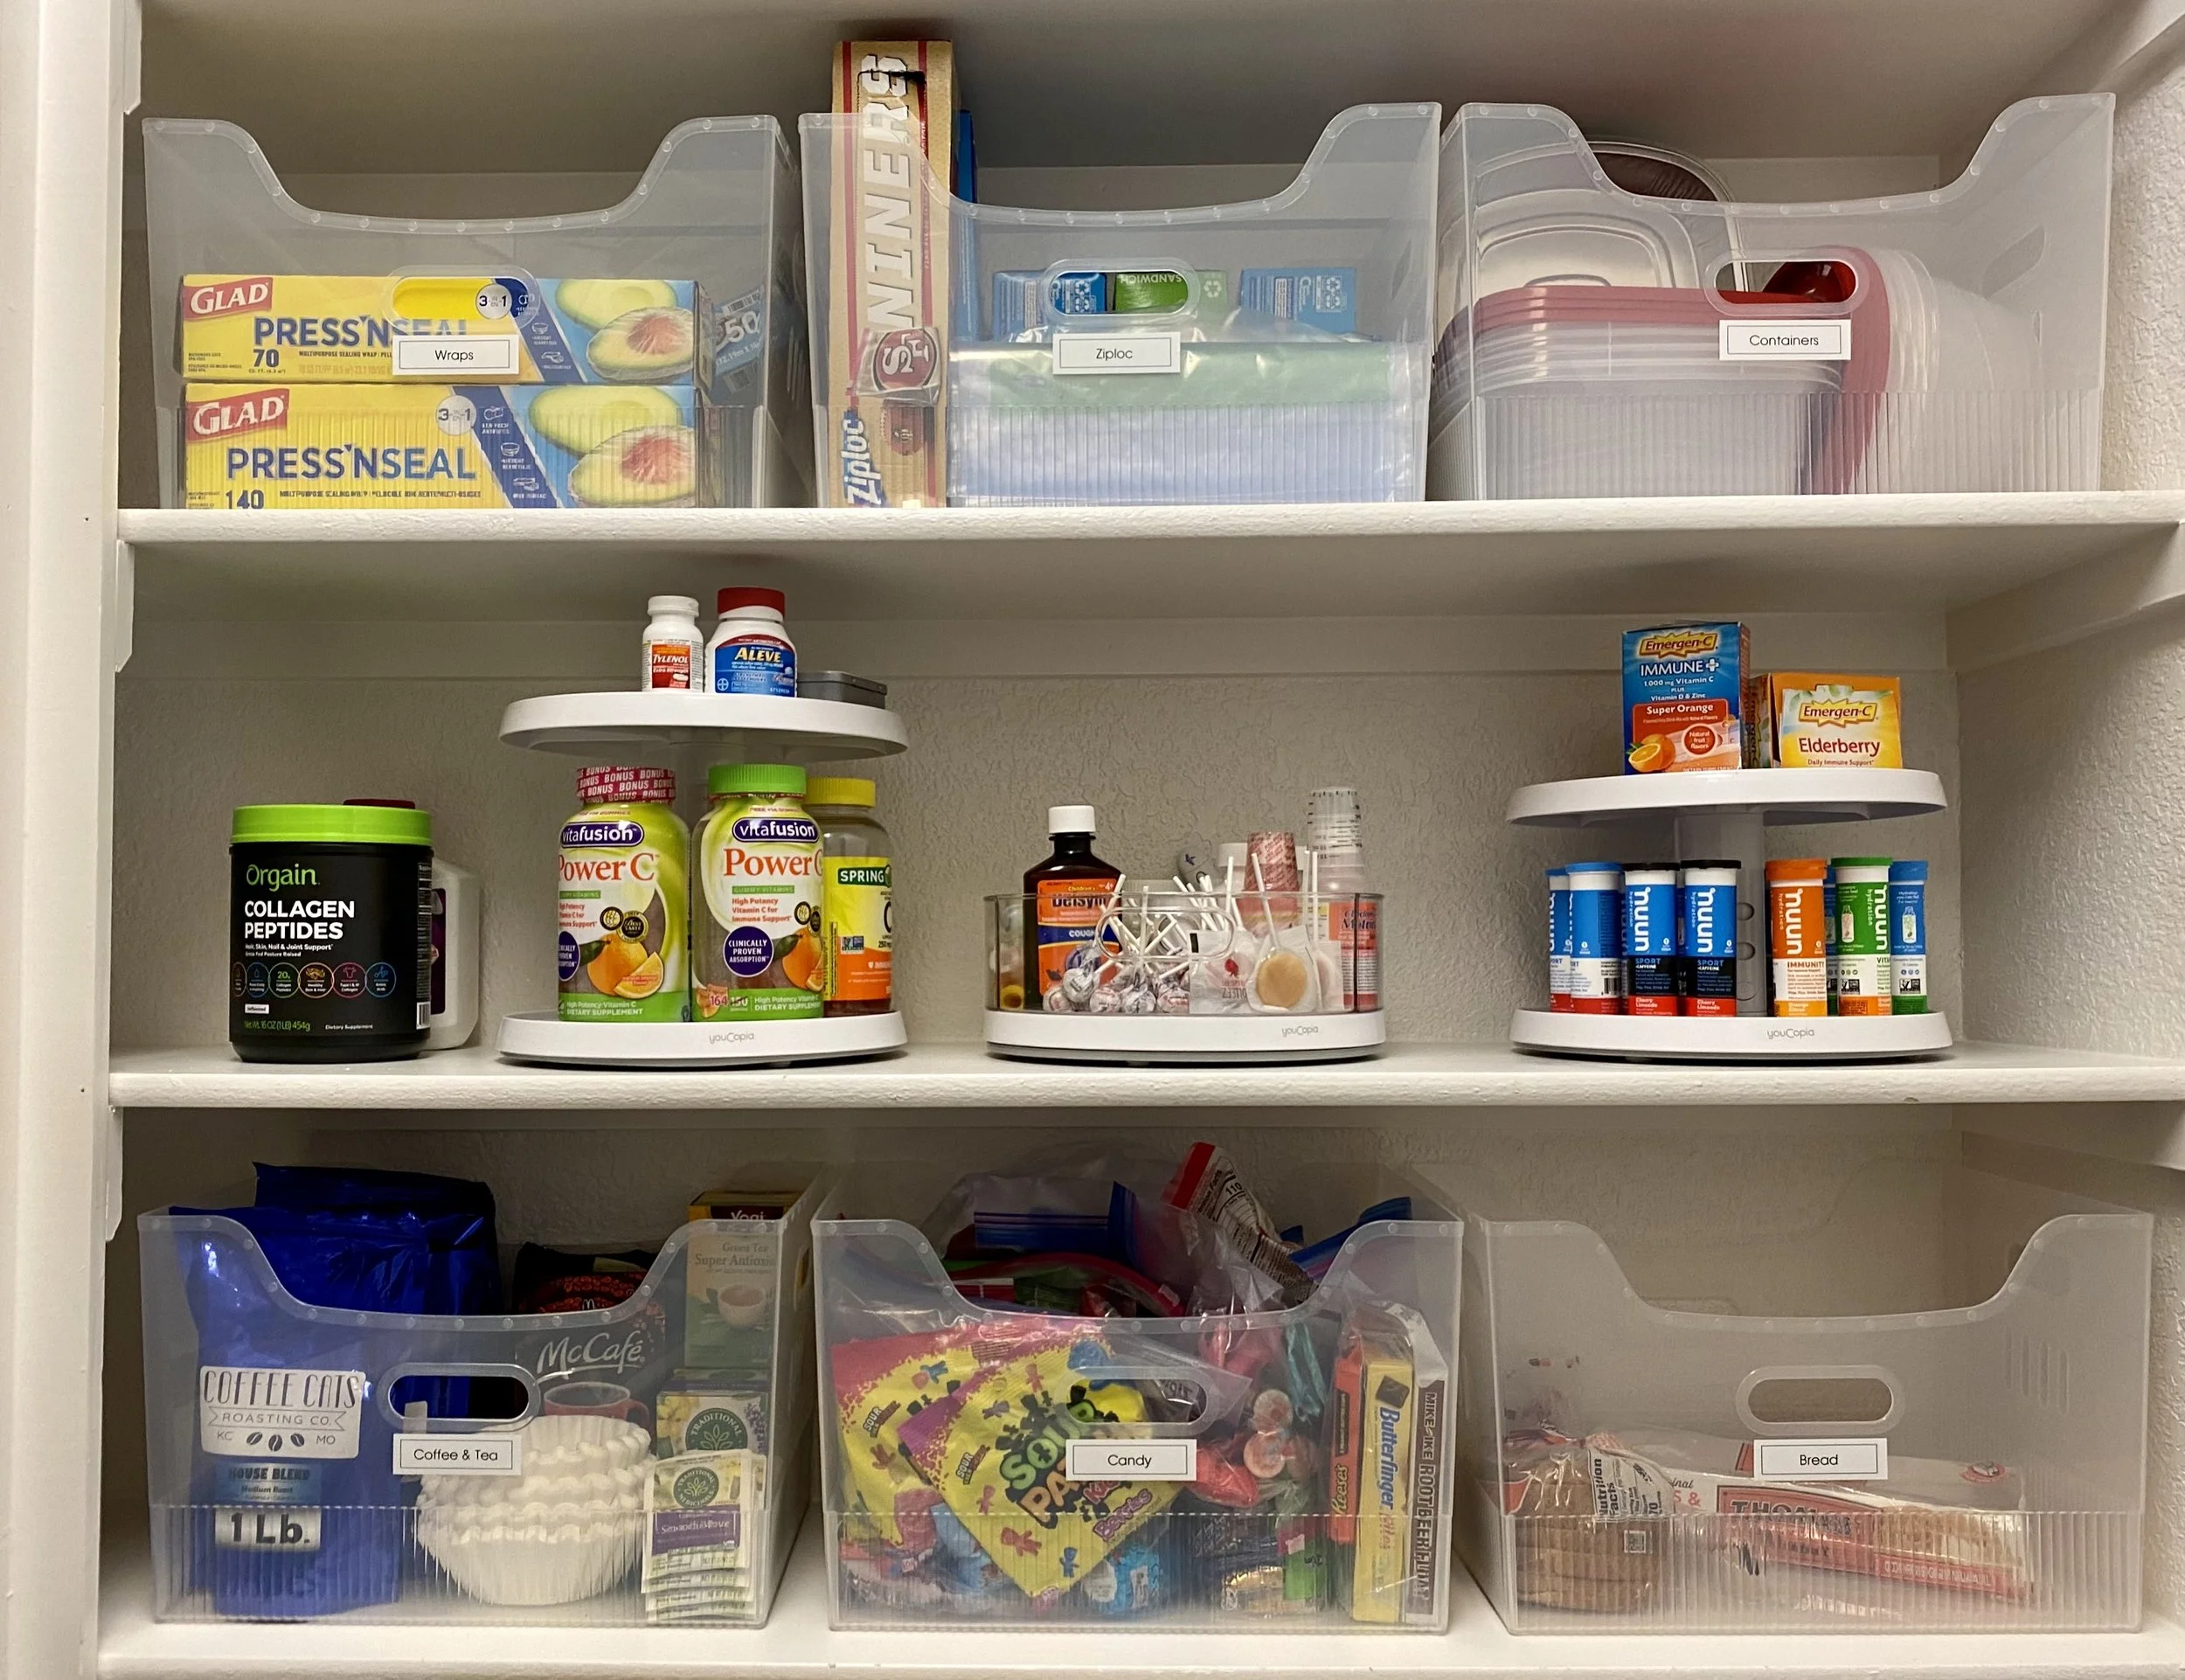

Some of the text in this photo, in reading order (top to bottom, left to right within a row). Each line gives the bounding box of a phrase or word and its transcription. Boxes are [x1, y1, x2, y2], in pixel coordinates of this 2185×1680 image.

[1120, 274, 1183, 284] SANDWICH
[190, 281, 270, 315] GLAD
[1749, 334, 1819, 347] Containers
[253, 349, 279, 367] 70
[434, 350, 474, 363] Wraps
[1095, 348, 1134, 360] Ziploc
[192, 395, 286, 436] GLAD
[225, 489, 265, 509] 140
[1645, 635, 1713, 651] Emergen-C
[653, 654, 689, 664] TYLENOL
[734, 647, 781, 663] ALEVE
[1675, 677, 1707, 685] Vitamin
[1647, 704, 1714, 716] Super Orange
[1803, 705, 1872, 720] Emergen-C
[1799, 738, 1881, 757] Elderberry
[604, 770, 635, 783] BONUS
[640, 769, 664, 779] BONUS
[587, 781, 649, 796] BONUS BONUS
[562, 826, 635, 843] vitafusion
[739, 821, 815, 837] vitafusion
[630, 852, 655, 881] C
[723, 848, 813, 878] Power
[246, 863, 318, 892] Orgain
[840, 870, 884, 883] SPRING
[245, 900, 355, 918] COLLAGEN
[1634, 886, 1651, 952] nuun
[1697, 887, 1716, 953] nuun
[1786, 888, 1804, 955] nuun
[1874, 885, 1888, 951] nuun
[245, 921, 343, 940] PEPTIDES
[728, 939, 767, 948] CLINICALLY
[710, 995, 728, 1006] 164
[772, 996, 797, 1004] Potency
[292, 1020, 310, 1031] 454g
[1281, 1025, 1319, 1038] youCopia
[1766, 1027, 1815, 1040] youCopia
[709, 1031, 755, 1045] youCopia
[1224, 1181, 1243, 1197] 110
[695, 1253, 726, 1269] Super
[537, 1330, 644, 1379] McCafé
[203, 1370, 359, 1409] COFFEE CATS
[1425, 1392, 1437, 1428] MIKE
[222, 1413, 332, 1426] ROASTING CO.
[690, 1412, 743, 1436] TRADITIONAL
[863, 1406, 883, 1432] SOUR
[217, 1431, 336, 1445] KC MO
[1000, 1400, 1095, 1490] SOUR
[413, 1447, 497, 1461] Coffee & Tea
[1423, 1436, 1435, 1461] IKE
[956, 1452, 975, 1479] SOUR
[1107, 1454, 1152, 1469] Candy
[1377, 1406, 1401, 1510] Butterfinger
[1799, 1453, 1839, 1468] Bread
[229, 1467, 310, 1481] HOUSE BLEND
[677, 1468, 716, 1486] TRADITIONAL
[1330, 1463, 1349, 1516] Reese's
[1419, 1463, 1436, 1506] ROOT
[1593, 1458, 1609, 1517] Nutrition
[1648, 1502, 1658, 1515] 70
[231, 1512, 310, 1545] 1 Lb.
[1417, 1509, 1434, 1549] BEER
